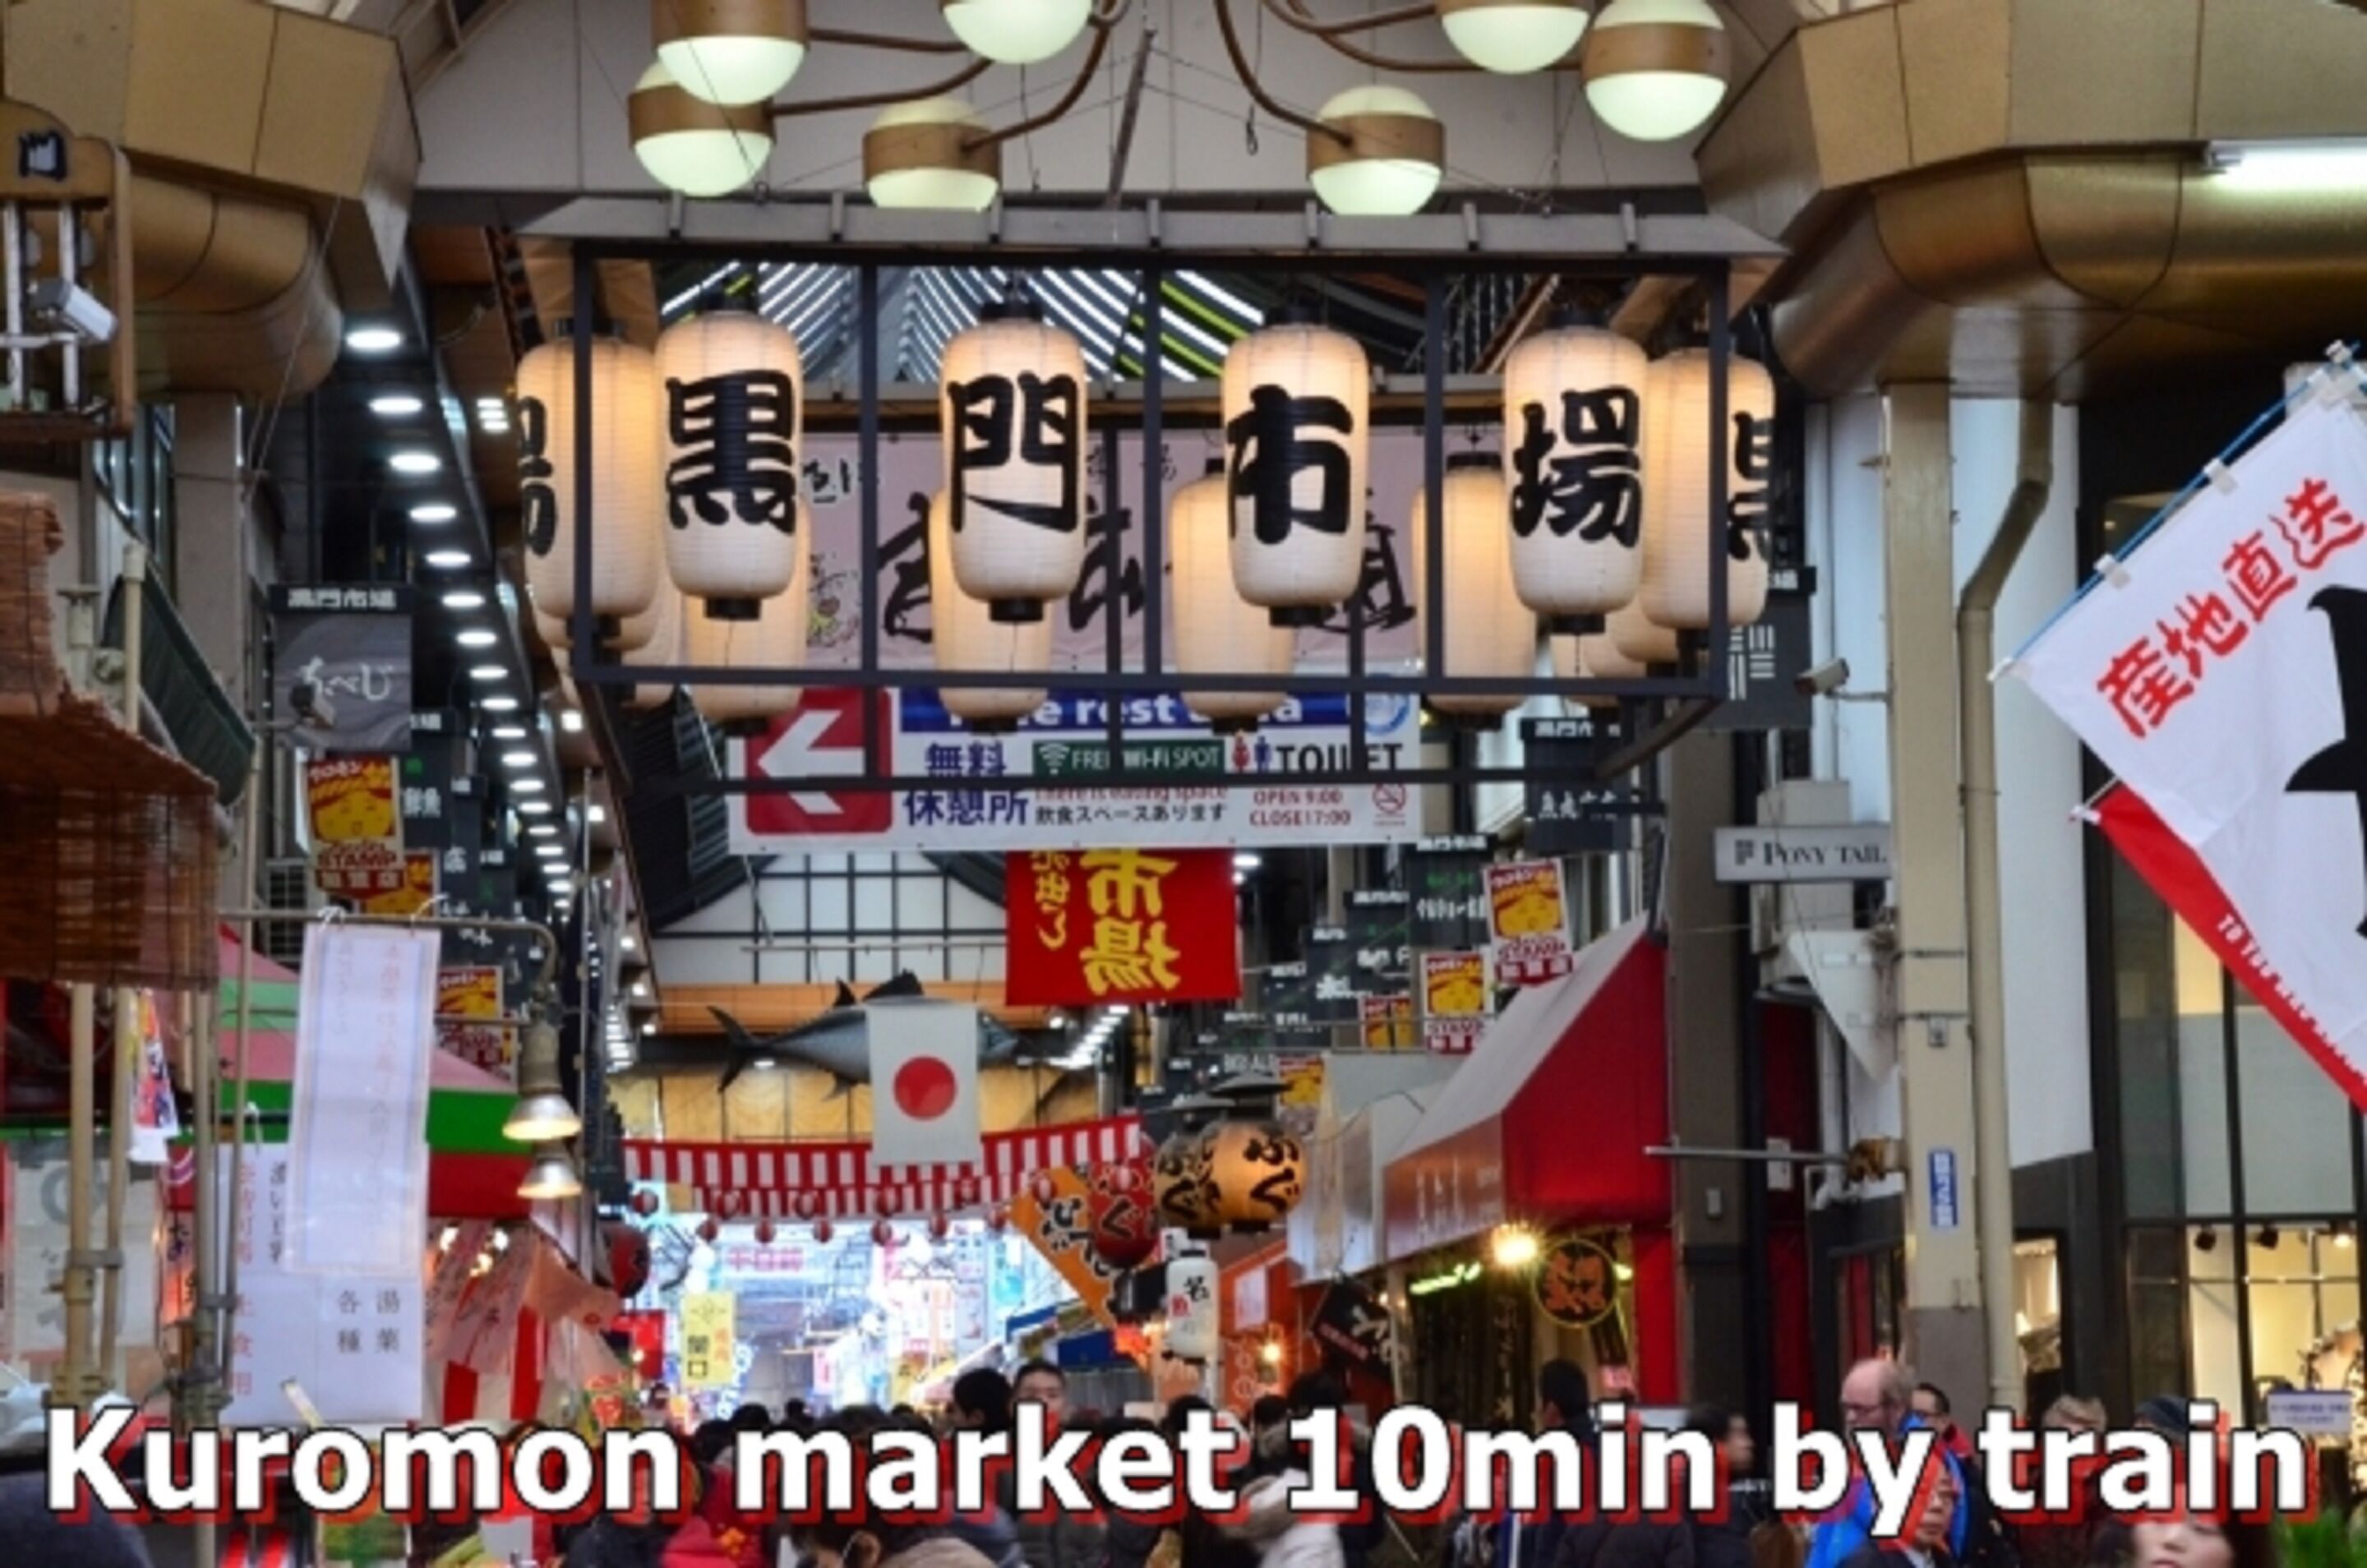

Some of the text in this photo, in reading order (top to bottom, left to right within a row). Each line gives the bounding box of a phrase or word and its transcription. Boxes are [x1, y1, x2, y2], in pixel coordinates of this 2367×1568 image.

[664, 370, 797, 536] 黒
[947, 370, 1078, 534] 門
[1227, 384, 1354, 544] 市
[1511, 385, 1643, 549] 場
[2097, 477, 2366, 738] 産地直送
[925, 740, 1006, 777] 無料
[1173, 745, 1220, 769] SPOT
[903, 786, 1029, 827] 休憩所
[1035, 803, 1230, 827] 飲食スペースあります
[1253, 786, 1345, 806] OPEN 9:00
[1249, 808, 1301, 828] CLOSE
[1243, 1137, 1300, 1212] ふぐ
[336, 1289, 362, 1354] 各種
